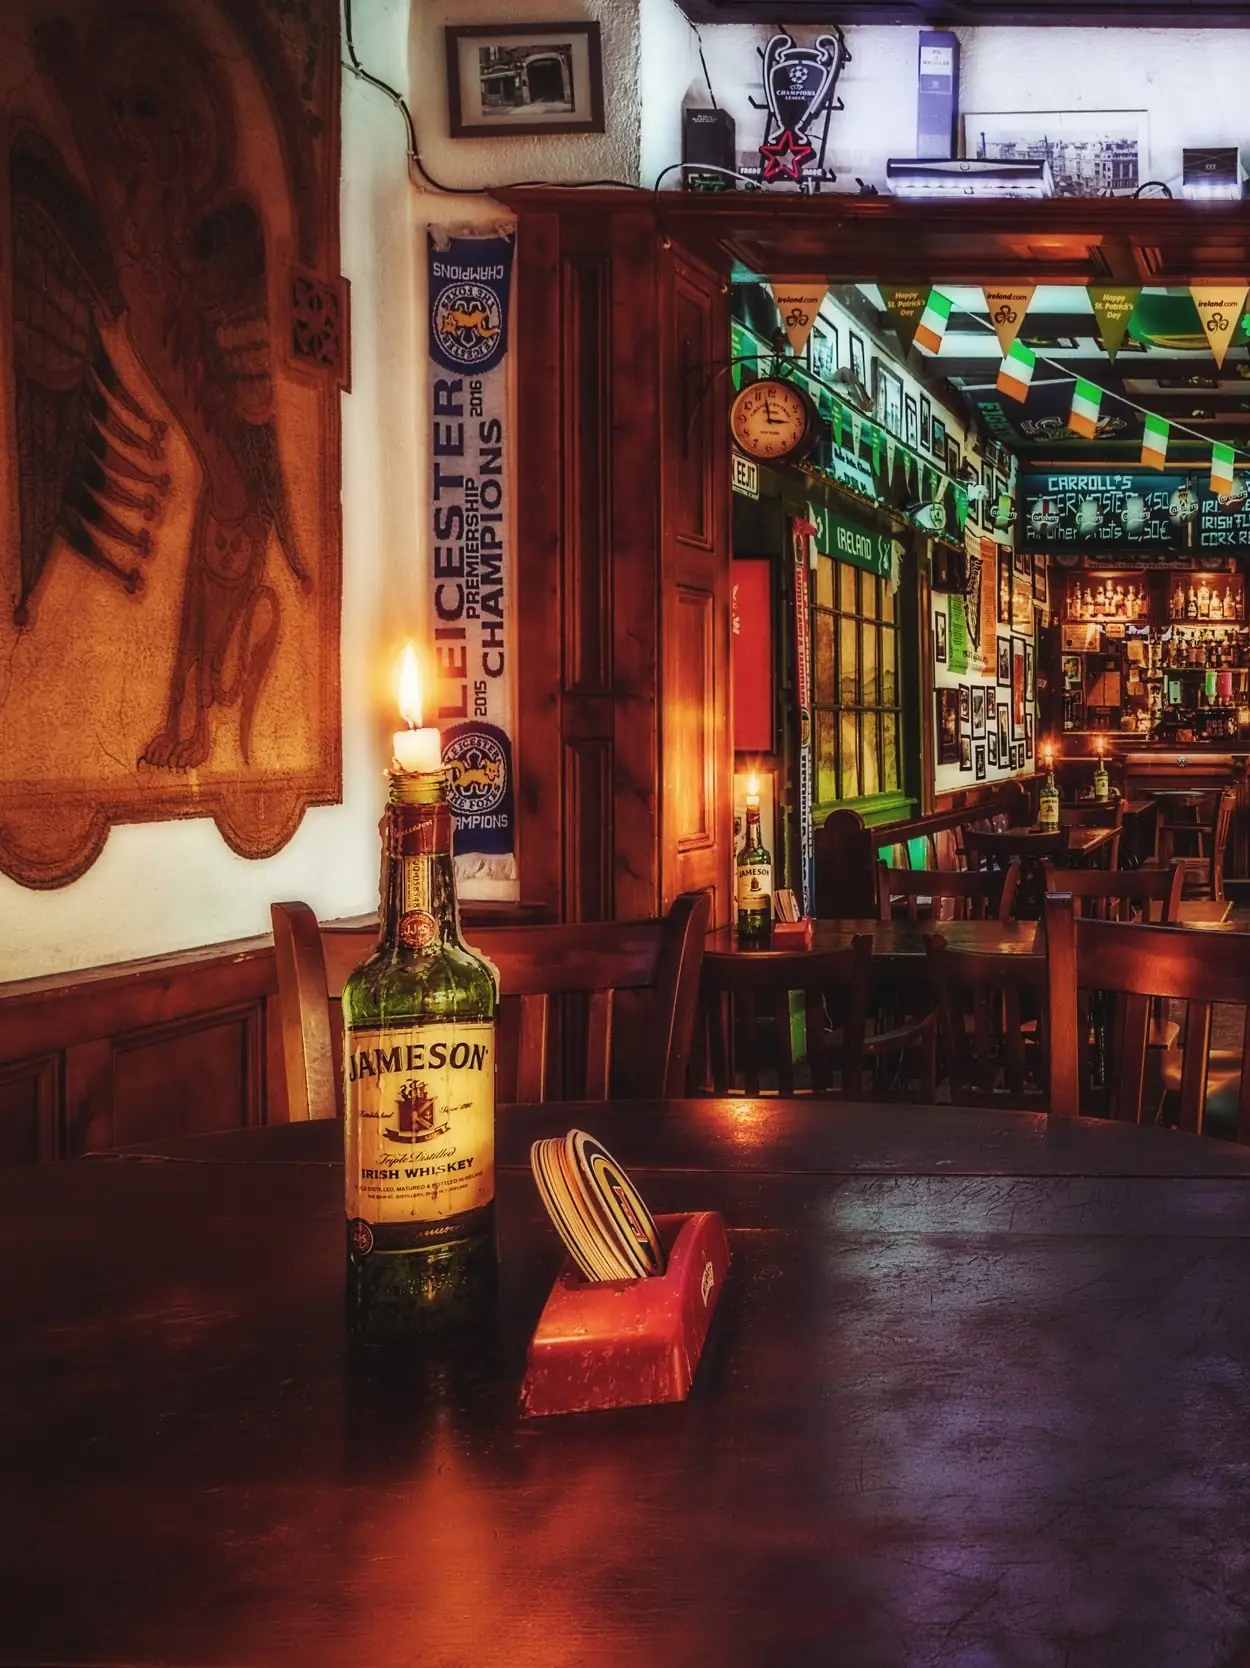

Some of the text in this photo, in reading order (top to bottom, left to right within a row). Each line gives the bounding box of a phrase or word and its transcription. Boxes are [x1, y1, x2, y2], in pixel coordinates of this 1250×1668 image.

[776, 89, 816, 97] CHAMPIONS
[433, 262, 504, 280] CHAMPIONS
[777, 296, 818, 304] ireland.com
[894, 291, 918, 301] Happy
[986, 292, 1027, 301] ireland.com
[1102, 293, 1126, 303] Happy
[897, 299, 926, 308] Patrick's
[1105, 302, 1134, 310] Patrick's
[1198, 300, 1238, 308] ireland.com
[900, 308, 914, 317] Day
[1106, 311, 1121, 320] Day
[1048, 475, 1133, 491] CARROLL'S
[1031, 512, 1060, 523] Carlsberg
[1201, 515, 1233, 529] IRISH
[837, 526, 872, 561] IRELAND
[1201, 532, 1237, 546] CORK
[433, 376, 468, 720] LEICESTER
[465, 379, 488, 717] 2015 PREMIERSHIP 2016
[479, 417, 504, 679] CHAMPIONS
[455, 814, 508, 830] AMPIONS
[350, 1042, 486, 1082] JAMESON
[375, 1146, 456, 1165] Triple Distilled
[362, 1157, 475, 1180] IRISH WHISKEY
